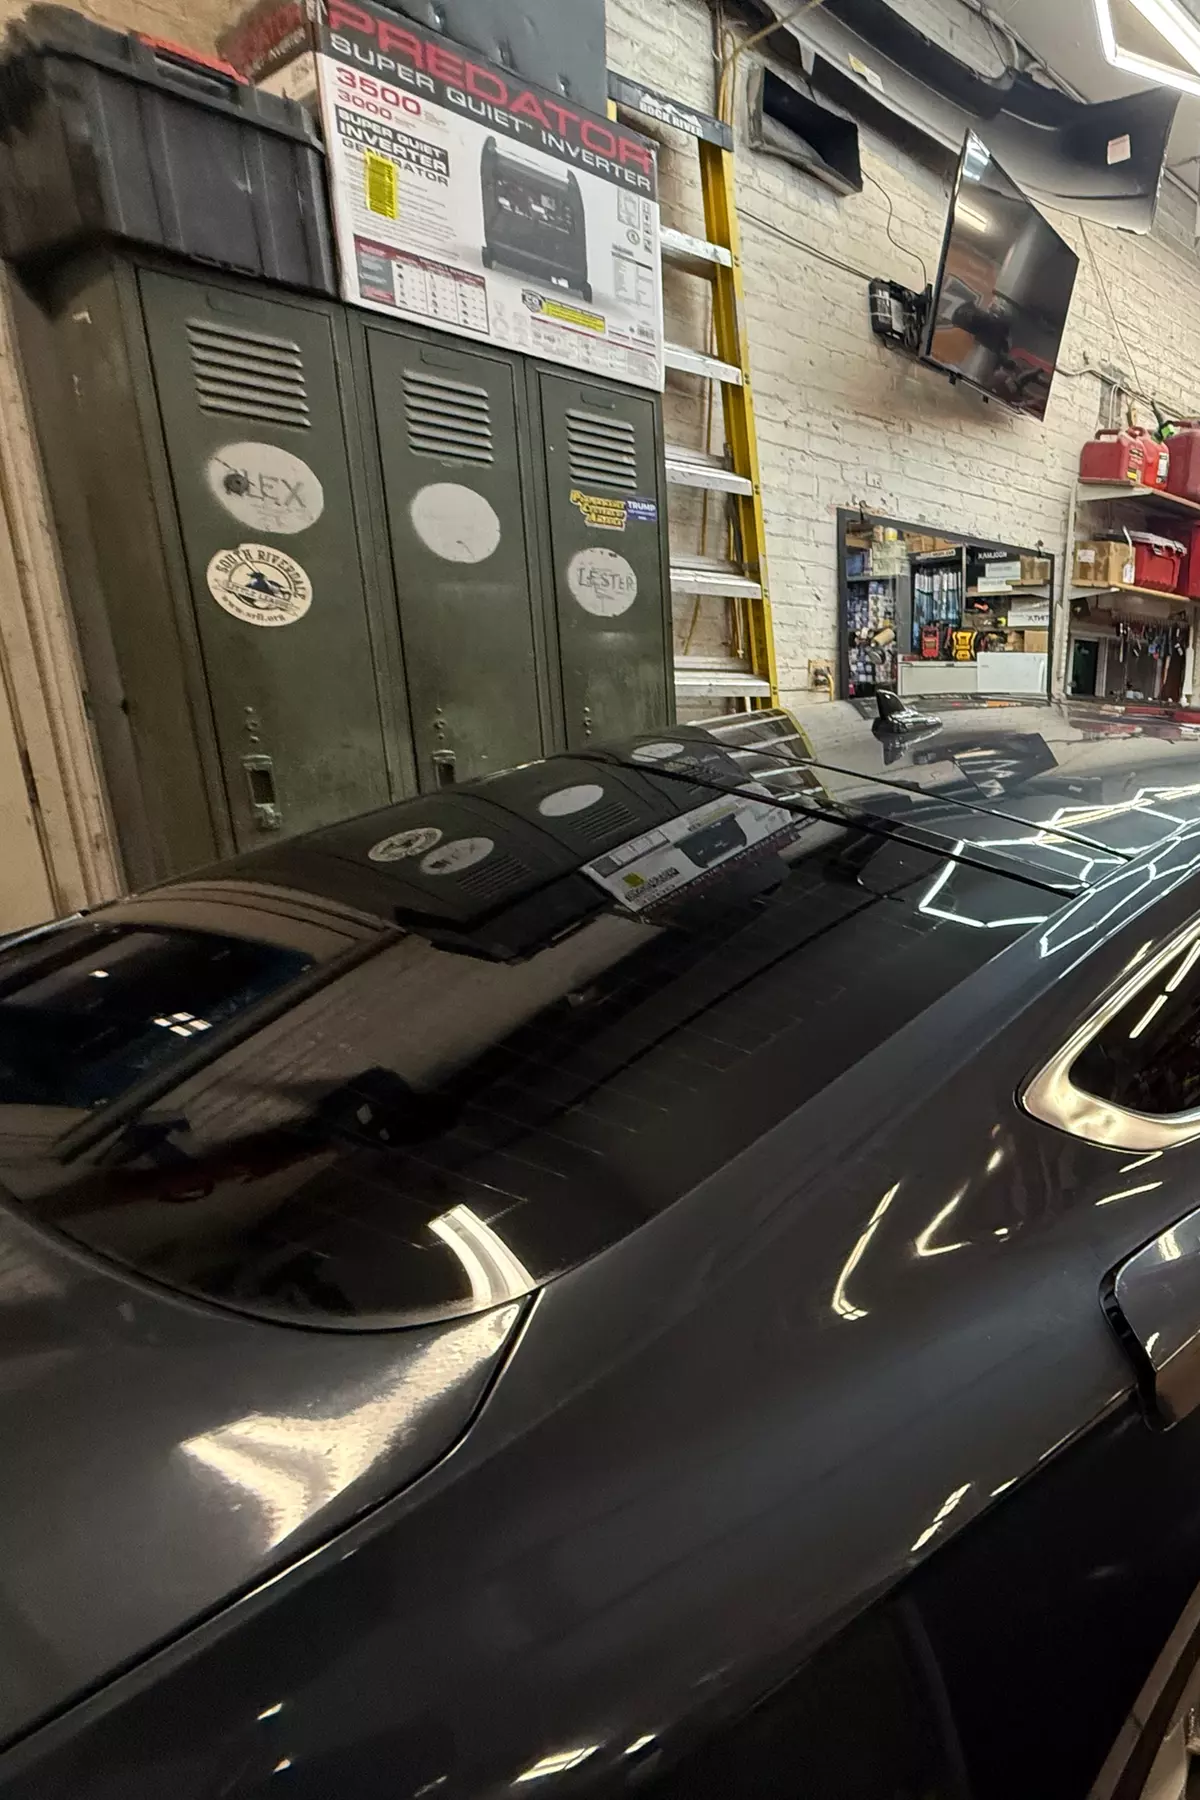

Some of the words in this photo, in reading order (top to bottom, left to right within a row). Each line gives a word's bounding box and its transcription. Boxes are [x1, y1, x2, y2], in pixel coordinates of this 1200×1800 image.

[327, 0, 652, 176] PREDATOR
[330, 32, 436, 94] SUPER
[541, 130, 651, 192] INVERTER
[336, 66, 421, 116] 3500
[337, 88, 392, 121] 3000
[340, 108, 394, 140] SUPER
[396, 133, 447, 159] QUIET
[340, 121, 447, 174] INVERTER
[223, 468, 307, 509] LEX
[627, 500, 656, 512] TRUMP
[577, 566, 637, 592] LESTER
